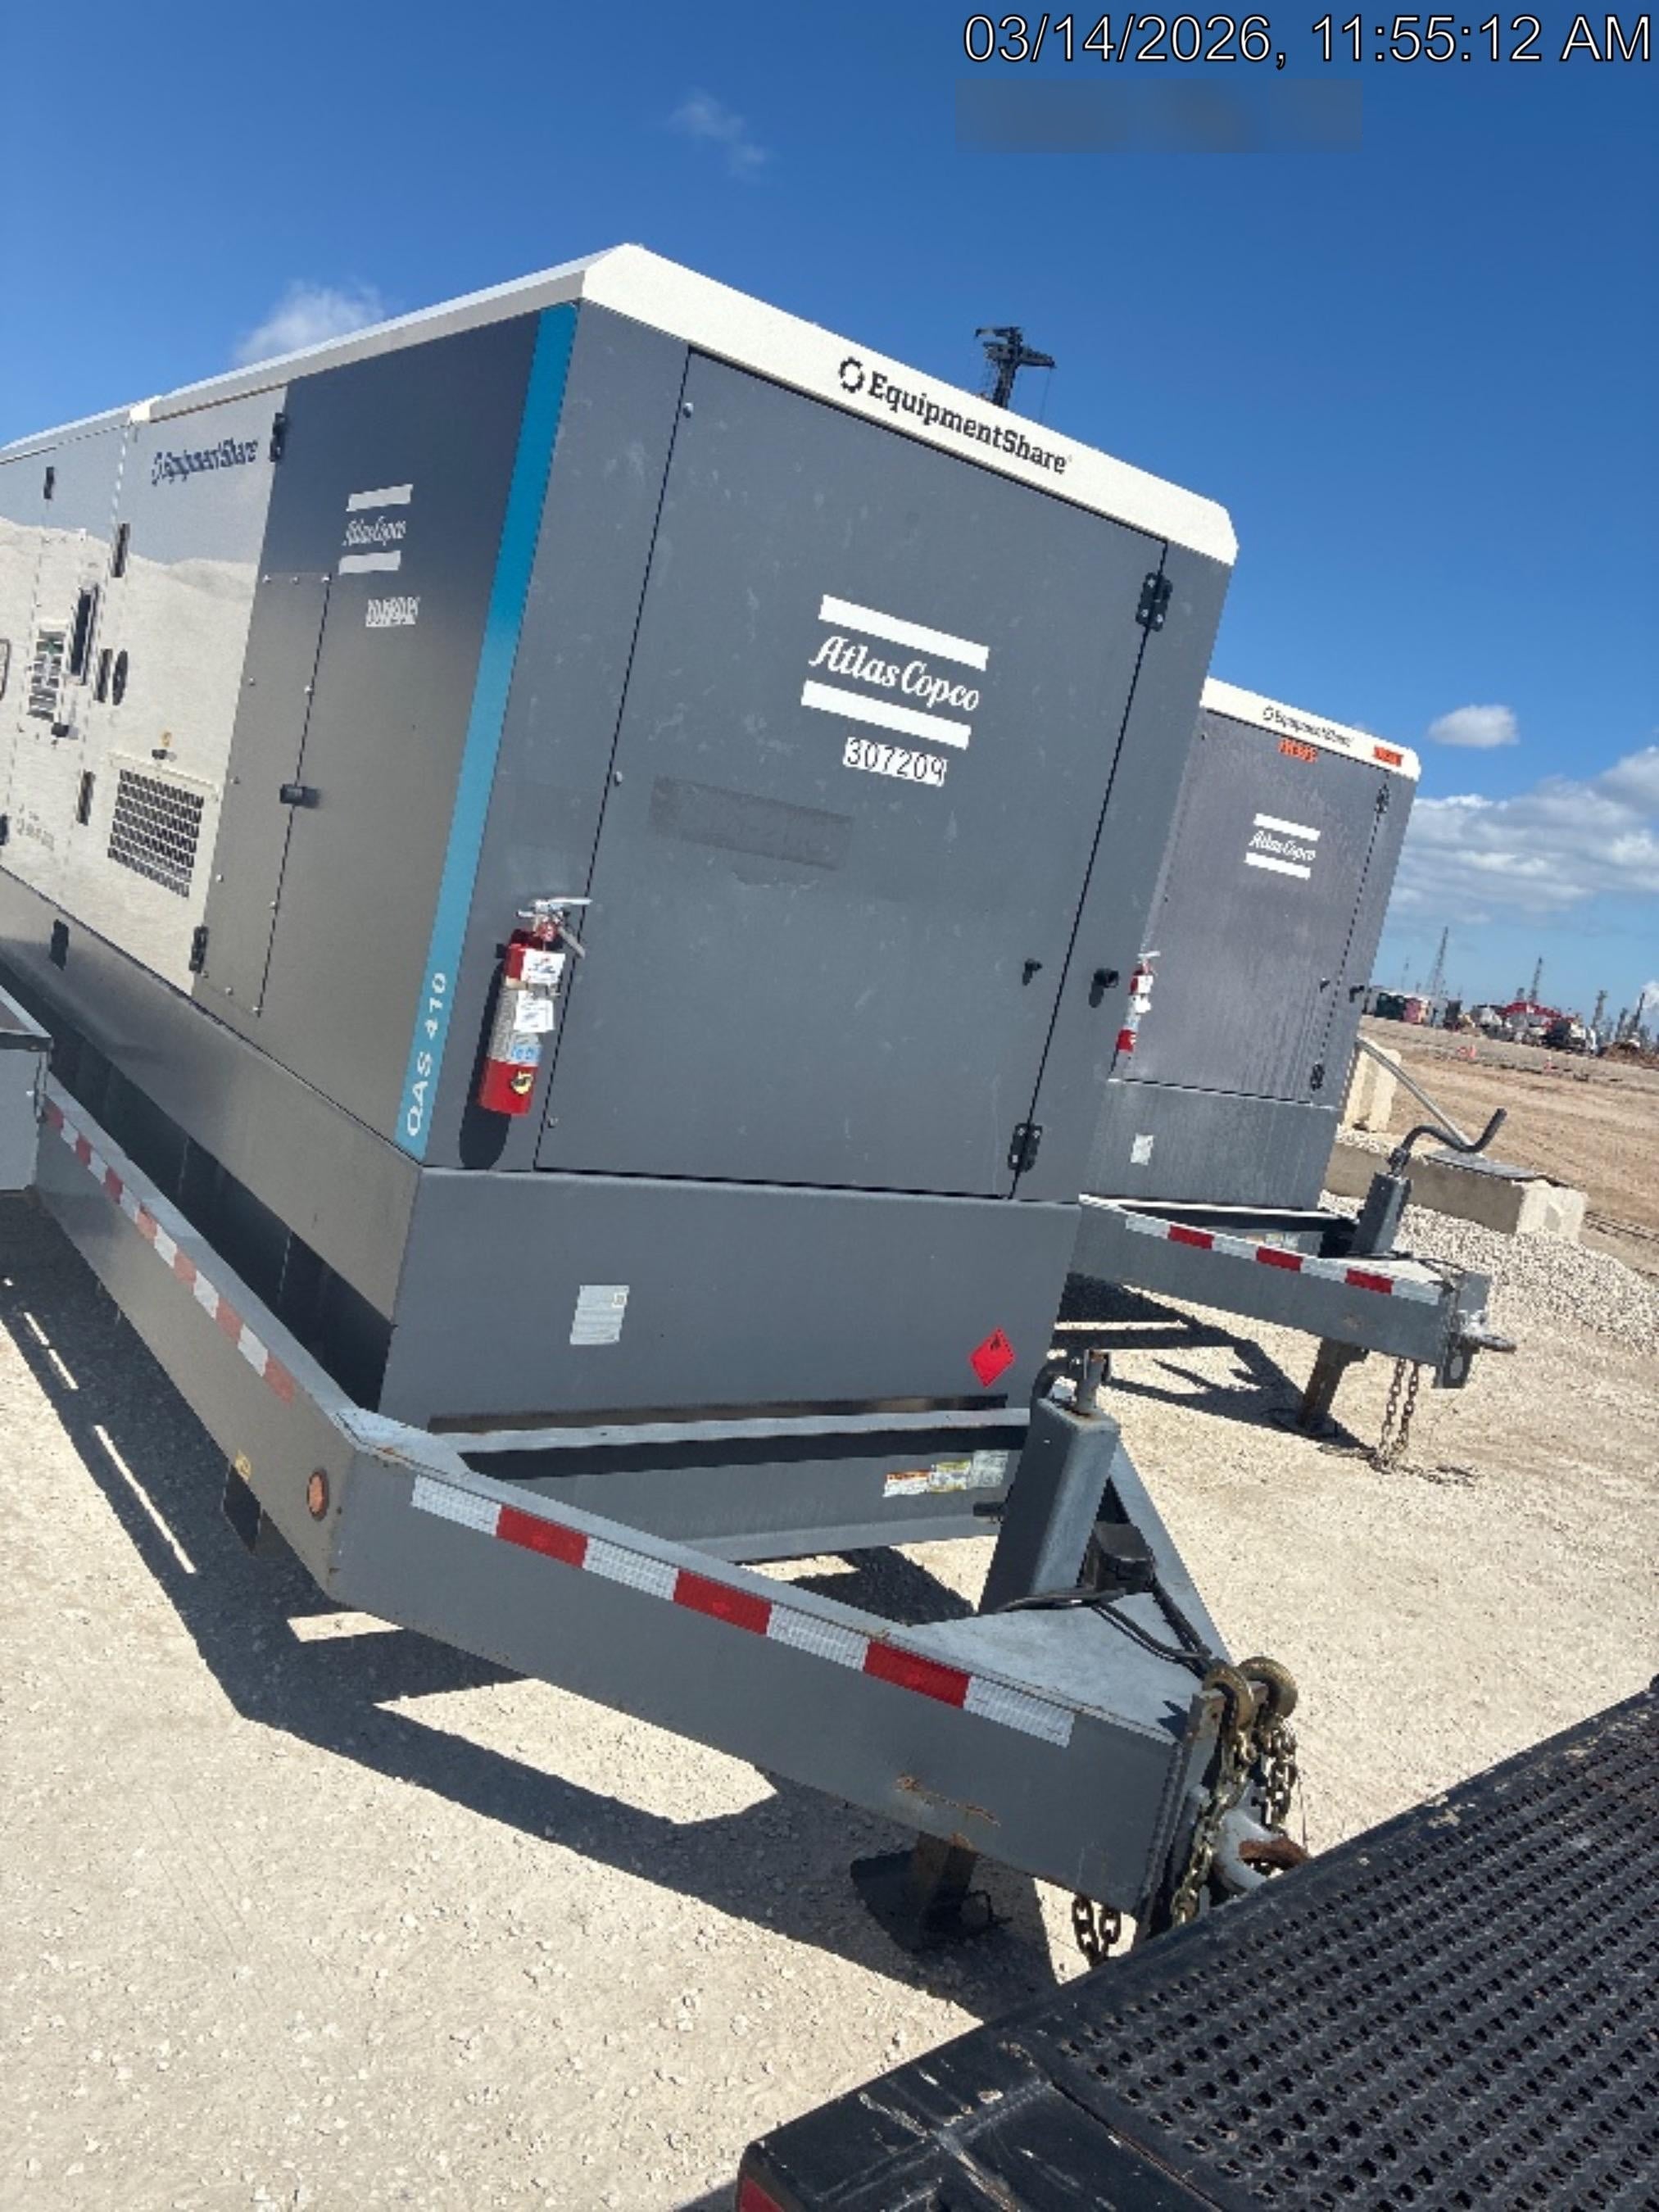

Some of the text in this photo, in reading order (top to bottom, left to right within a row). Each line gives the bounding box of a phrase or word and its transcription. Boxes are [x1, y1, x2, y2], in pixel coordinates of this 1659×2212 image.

[868, 370, 1067, 474] EquipmentShare
[845, 737, 945, 783] 307209
[406, 1050, 433, 1137] QAS
